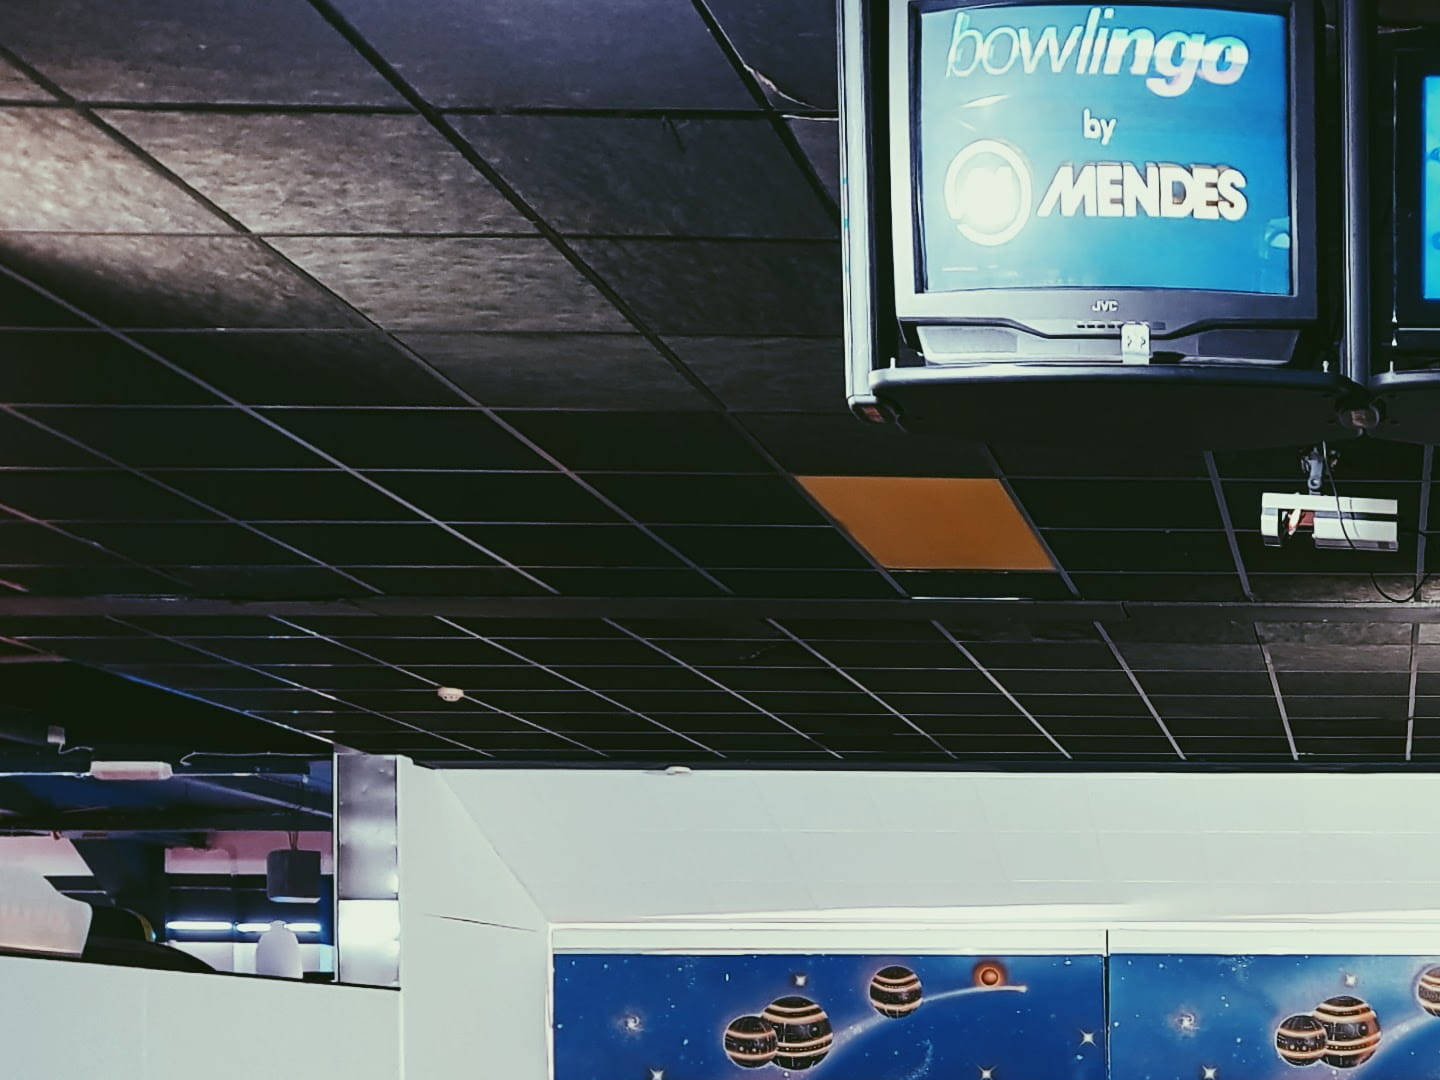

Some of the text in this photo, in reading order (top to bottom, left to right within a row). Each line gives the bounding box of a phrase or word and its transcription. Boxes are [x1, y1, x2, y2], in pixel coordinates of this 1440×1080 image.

[946, 8, 1249, 97] bowlingo
[1083, 109, 1117, 145] by
[1037, 161, 1248, 222] MENDES
[1091, 300, 1119, 312] JVC
